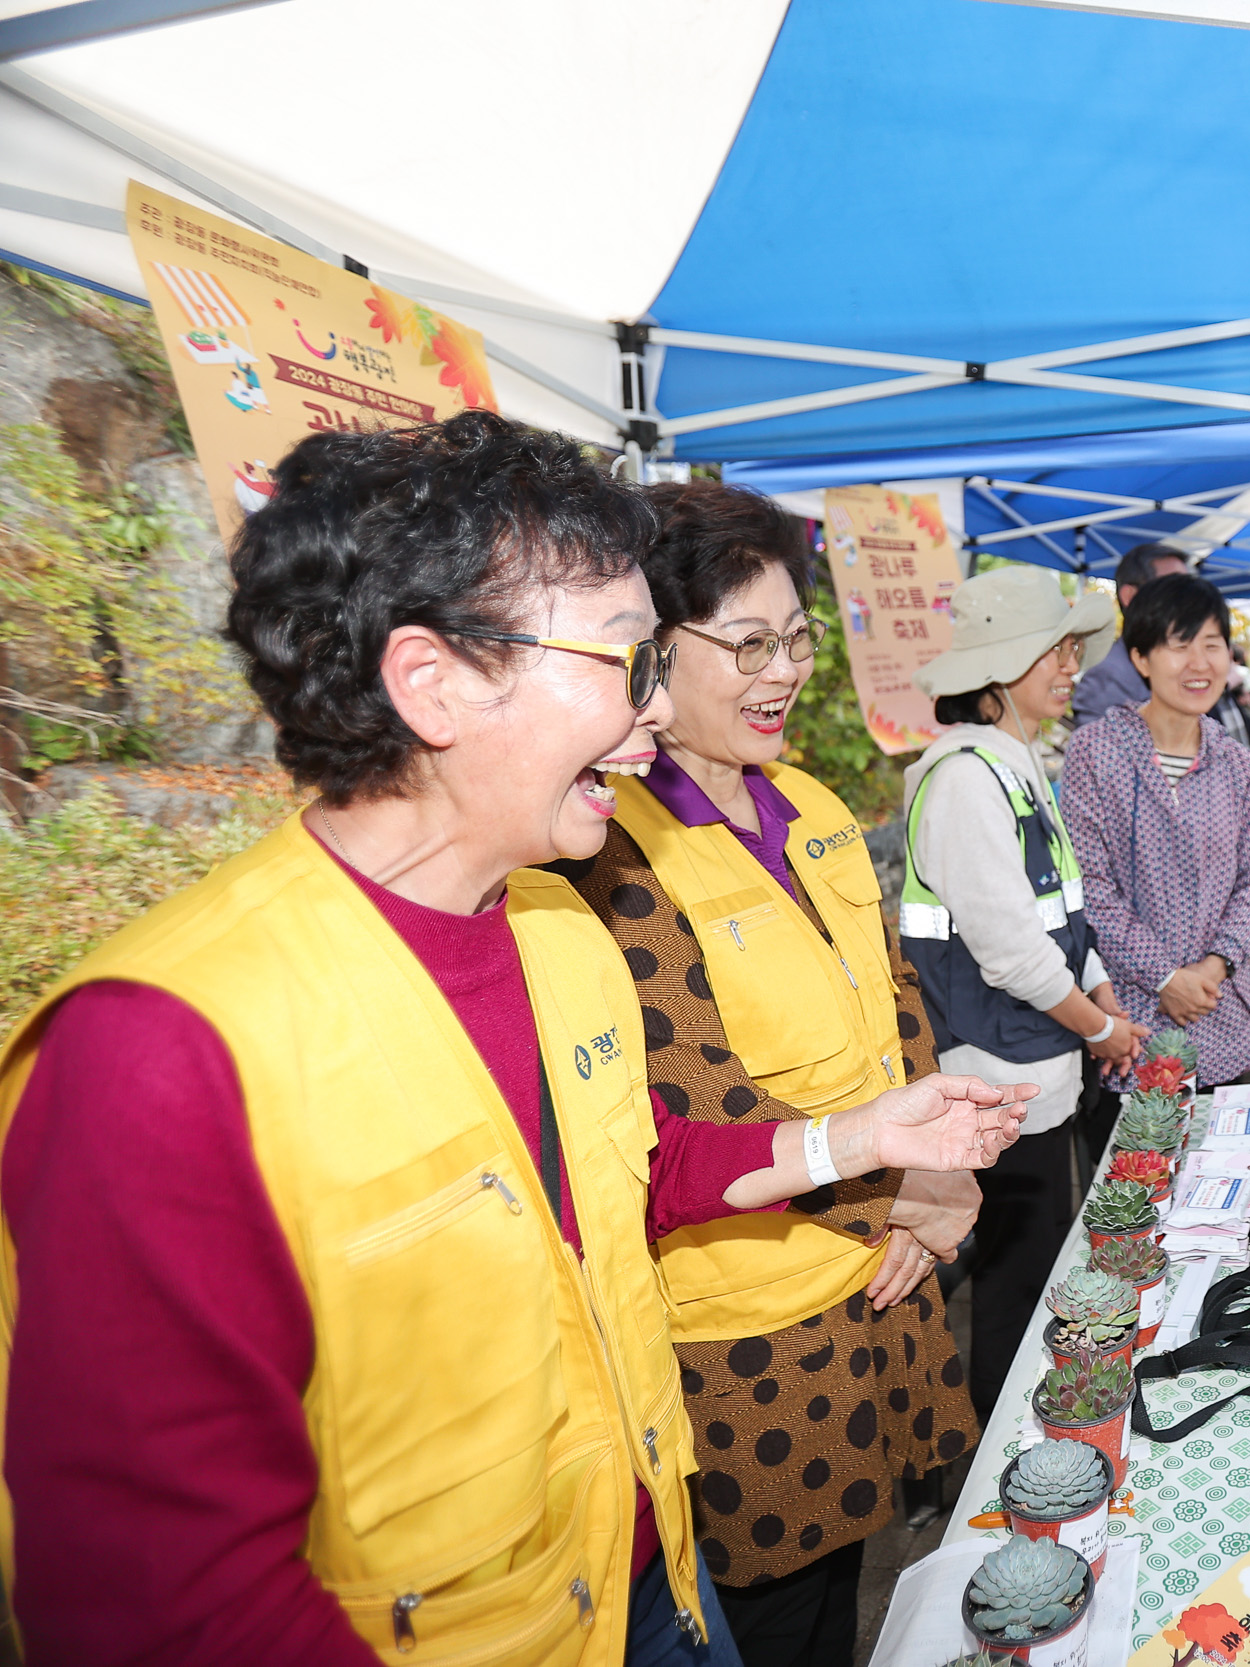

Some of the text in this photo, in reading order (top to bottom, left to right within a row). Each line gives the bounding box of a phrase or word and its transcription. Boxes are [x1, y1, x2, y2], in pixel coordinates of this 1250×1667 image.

[288, 365, 327, 388] 2024
[327, 375, 365, 401] 광장동
[869, 554, 917, 578] 광나루
[876, 587, 928, 609] 해오름
[894, 619, 929, 640] 축제
[822, 823, 857, 846] 광진구
